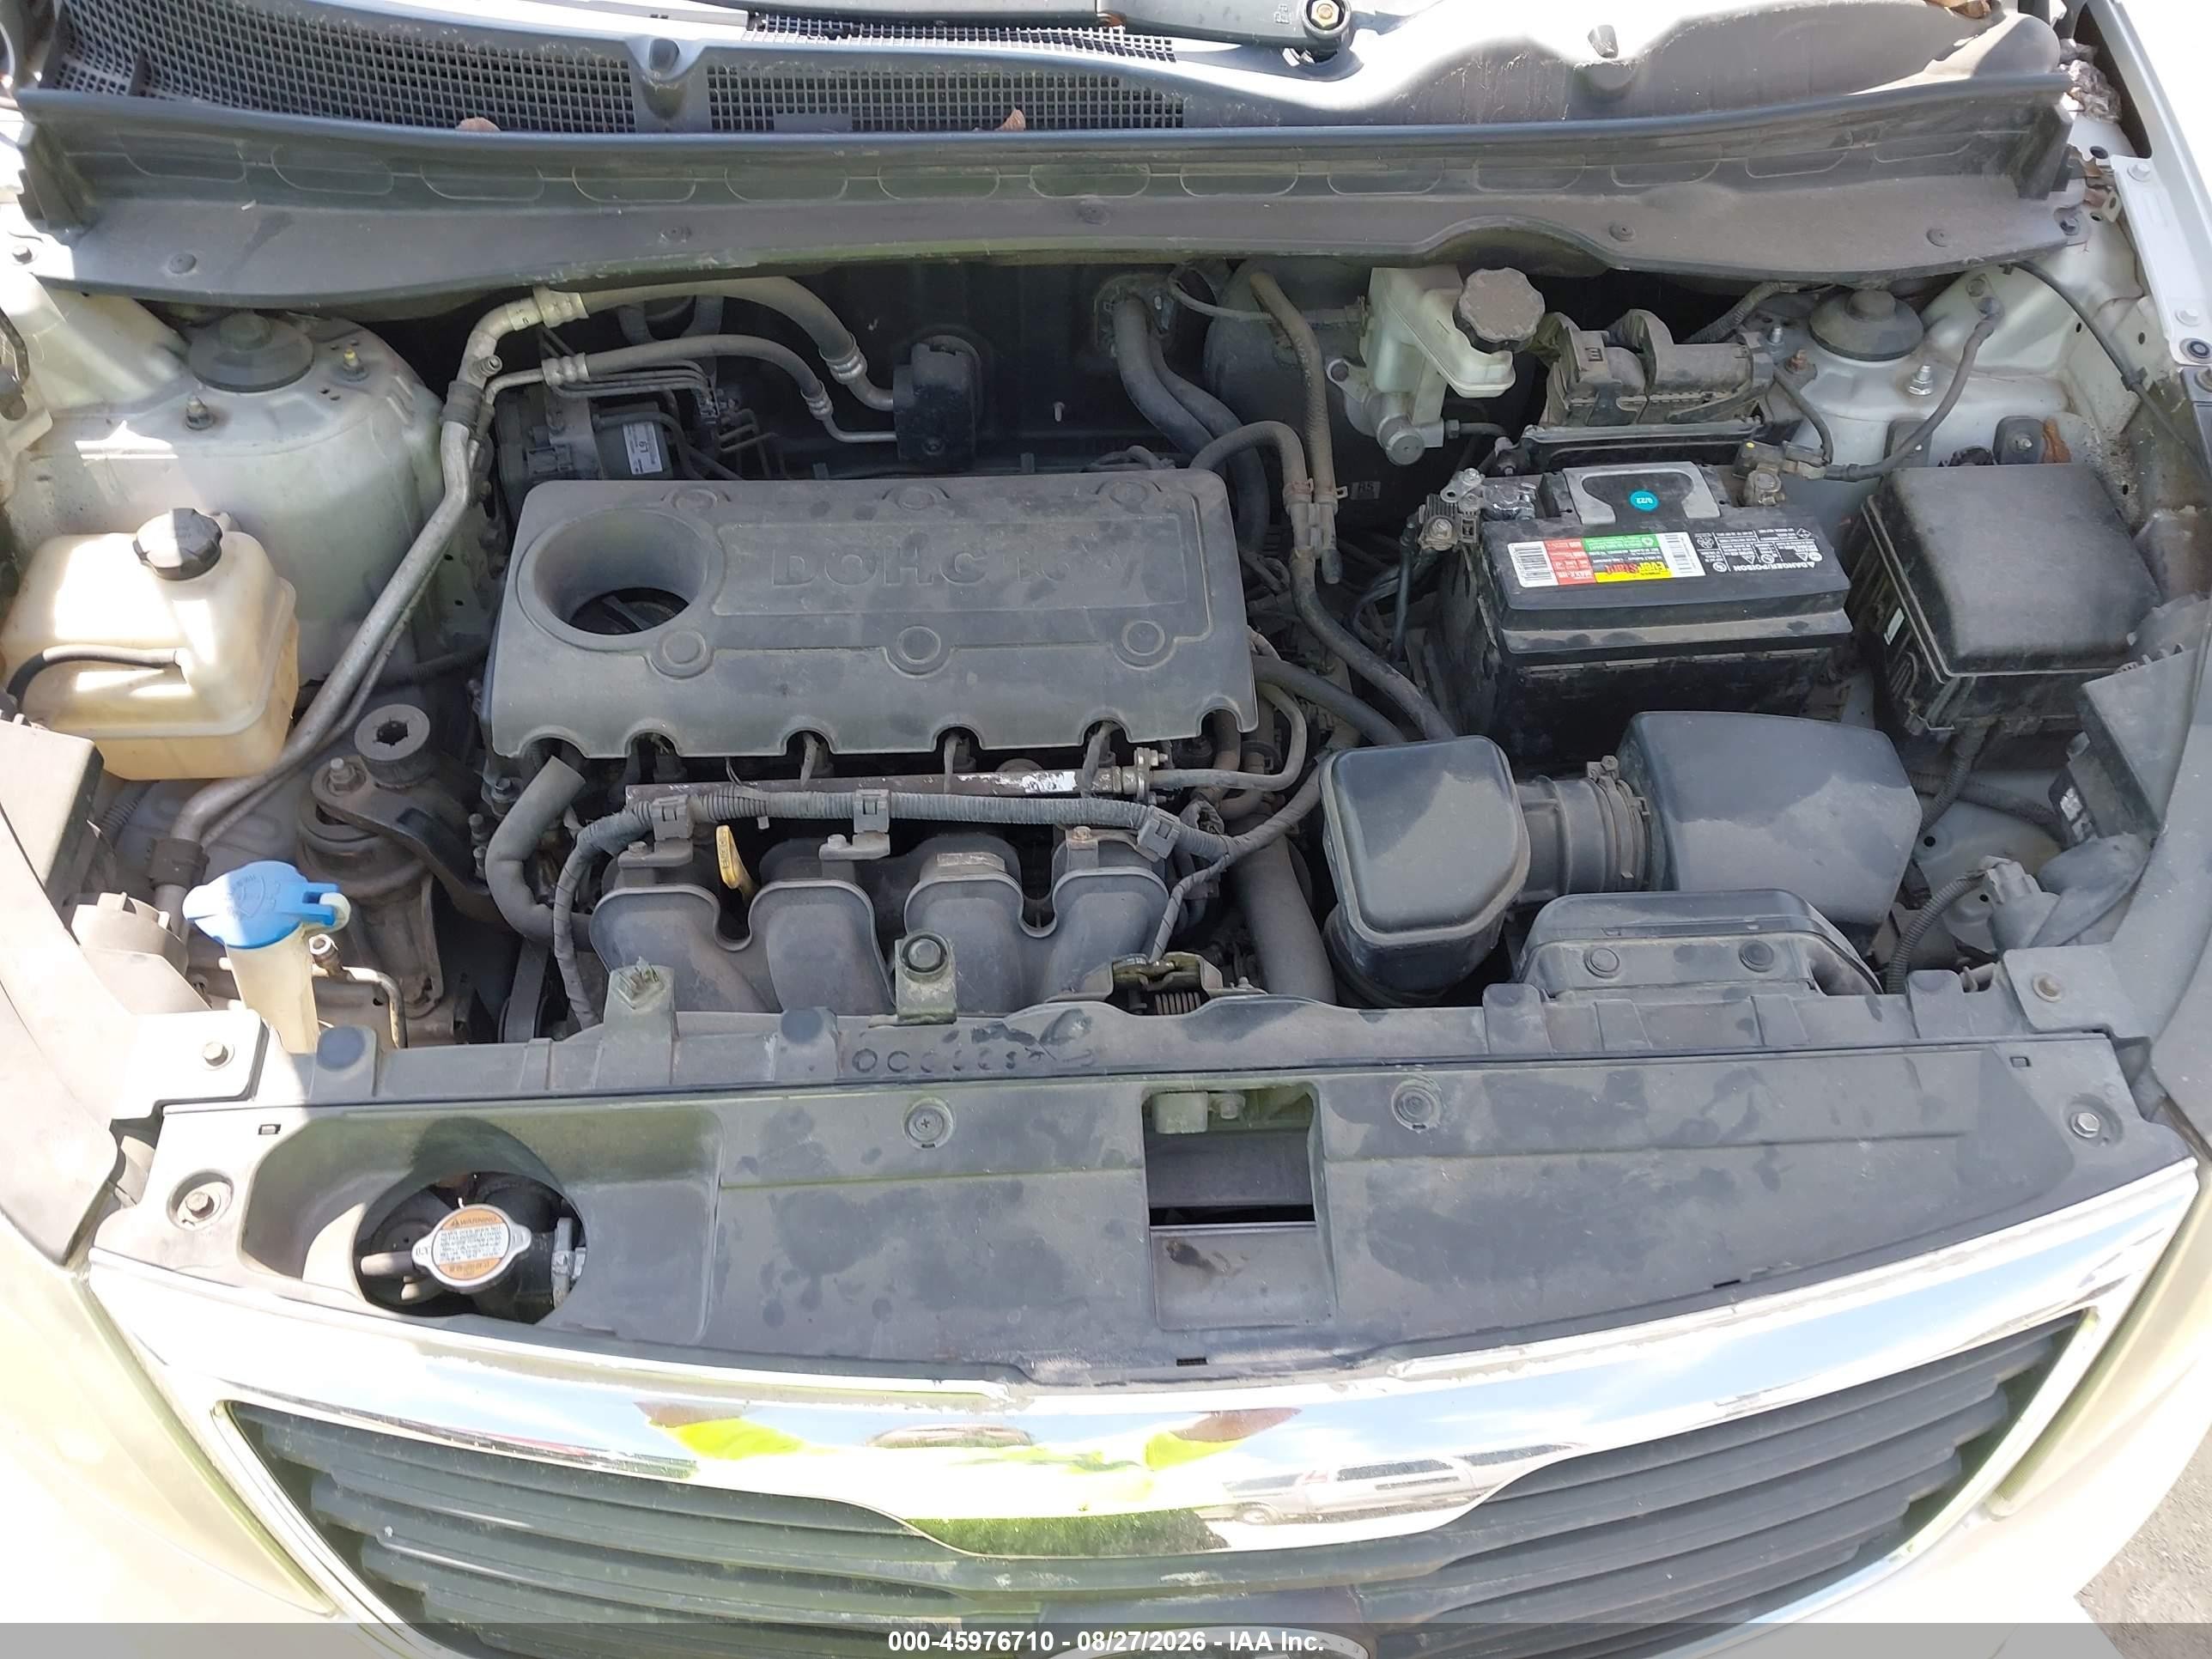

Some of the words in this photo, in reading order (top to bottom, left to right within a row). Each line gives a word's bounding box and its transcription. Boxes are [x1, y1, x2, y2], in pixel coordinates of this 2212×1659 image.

[772, 546, 988, 586] DOHC
[1733, 562, 1808, 572] DANGER/POISON
[460, 1216, 498, 1225] WARNING
